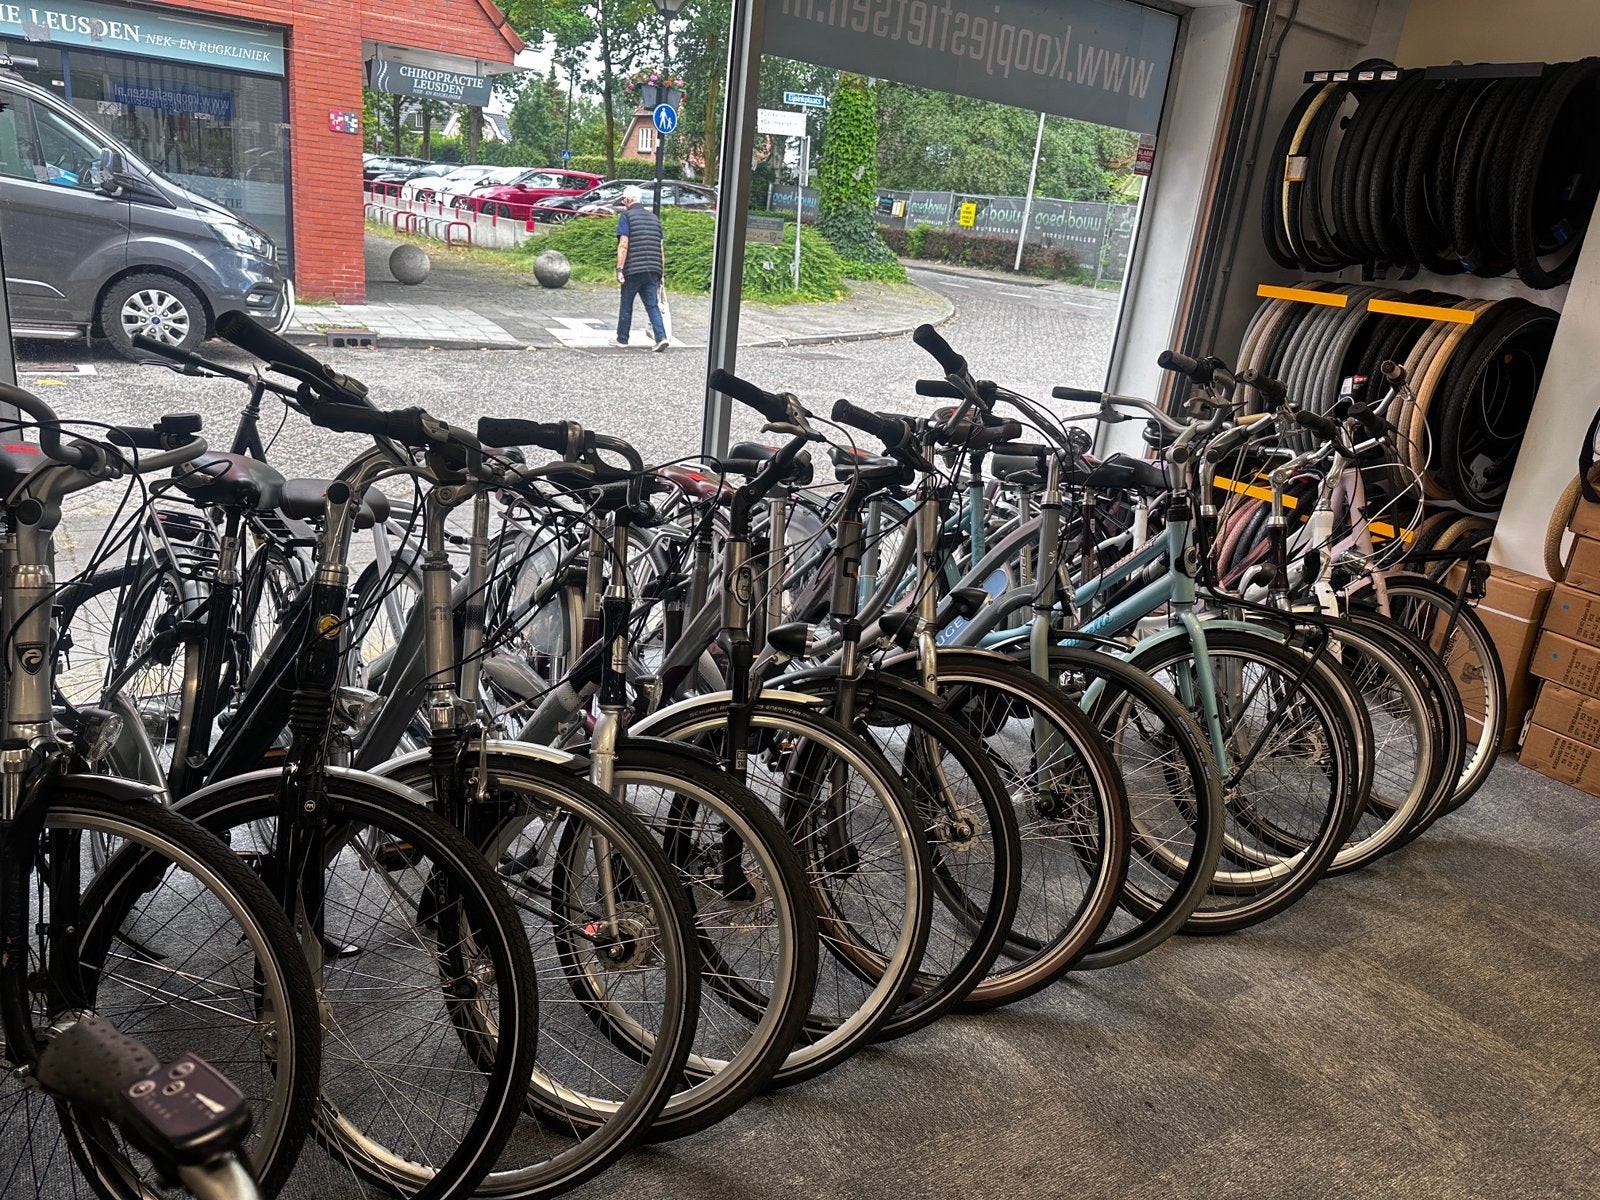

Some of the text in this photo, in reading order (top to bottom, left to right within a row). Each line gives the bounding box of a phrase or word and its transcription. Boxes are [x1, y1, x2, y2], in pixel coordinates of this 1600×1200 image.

[179, 39, 197, 51] EN
[199, 41, 272, 62] RUGKLINIEK
[400, 66, 484, 89] CHIROPRACTIE
[413, 79, 464, 96] LEUSDEN
